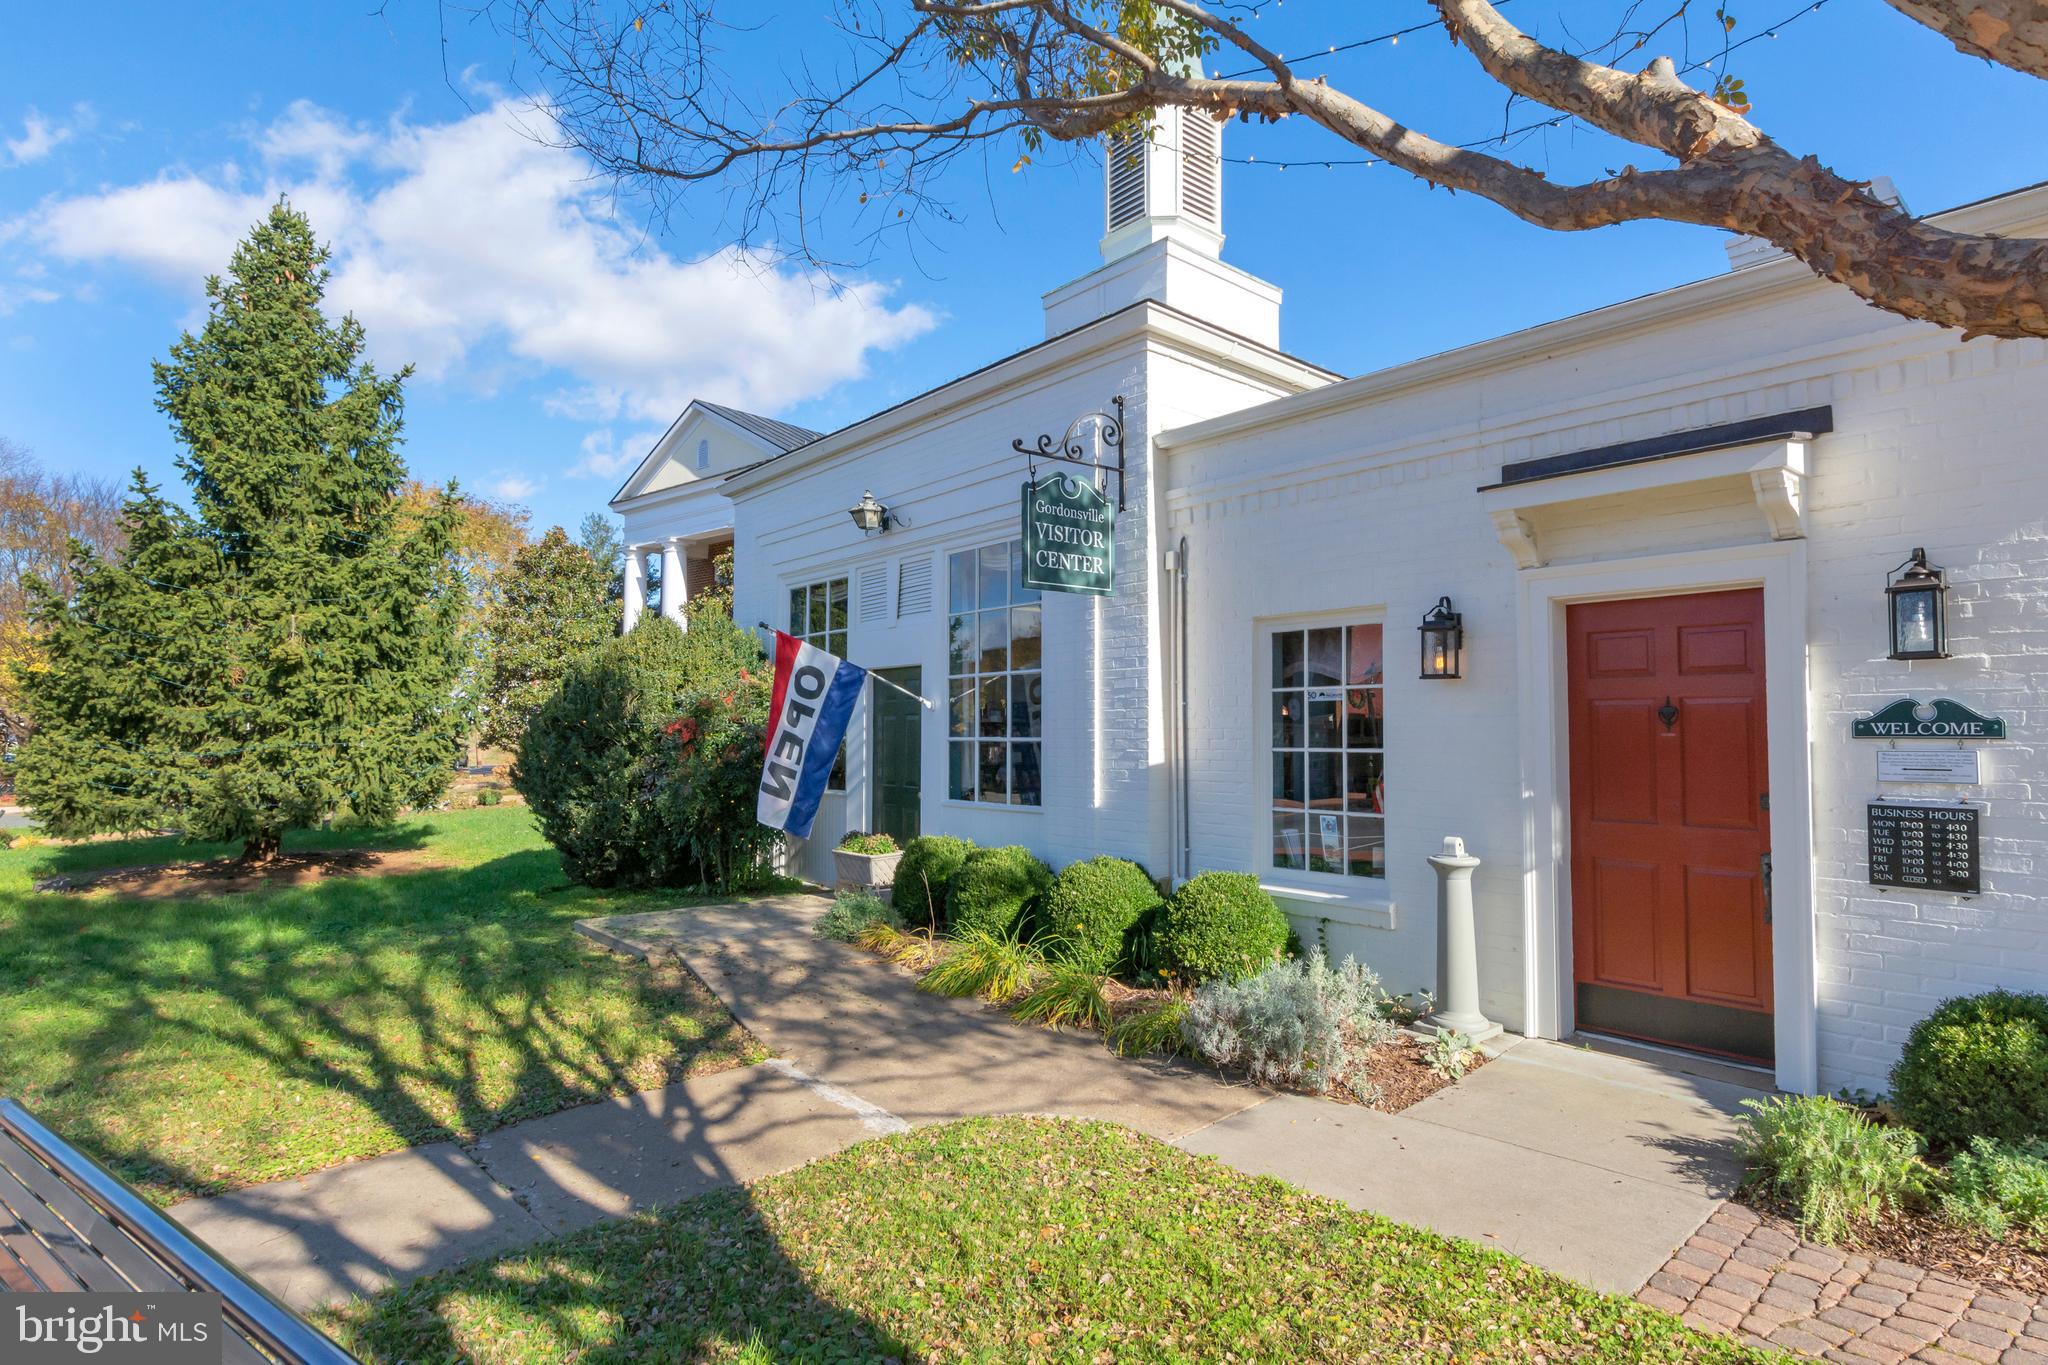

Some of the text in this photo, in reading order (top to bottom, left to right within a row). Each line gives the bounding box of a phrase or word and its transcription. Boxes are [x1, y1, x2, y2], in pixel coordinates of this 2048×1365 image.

[1035, 500, 1104, 523] Gordonsville
[1035, 522, 1104, 548] VISITOR
[1036, 550, 1104, 574] CENTER
[1870, 722, 1984, 735] WELCOME
[1871, 808, 1974, 820] BUSINESS HOURS
[1900, 821, 1923, 829] 10:00
[1873, 828, 1890, 836] TUE
[1873, 837, 1895, 846] WED
[1873, 846, 1893, 854] THU
[1902, 866, 1924, 874] 11:00
[1873, 873, 1893, 881] SUN
